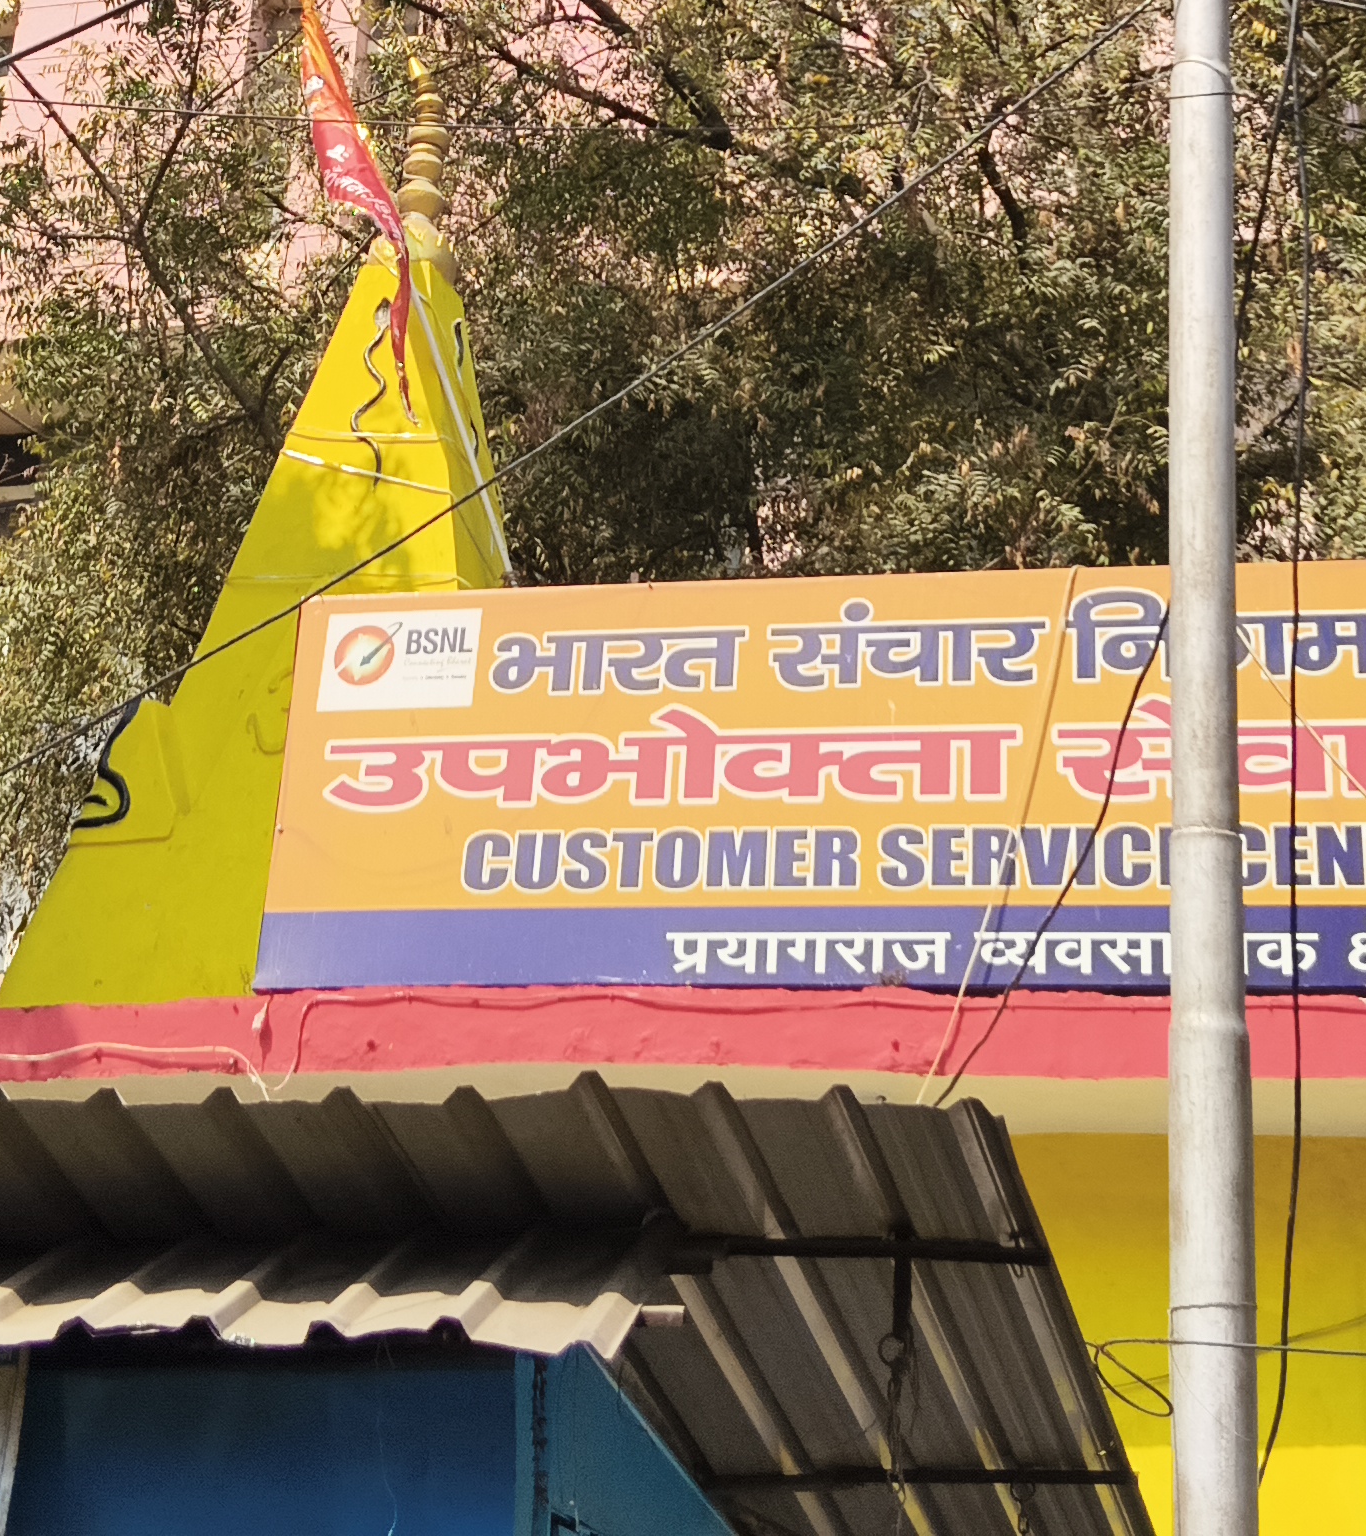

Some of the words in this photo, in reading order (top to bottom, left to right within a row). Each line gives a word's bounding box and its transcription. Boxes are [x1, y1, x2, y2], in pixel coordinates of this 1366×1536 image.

[405, 626, 473, 655] BSNL
[490, 626, 746, 695] भारत
[769, 598, 1048, 689] संचार
[323, 704, 1021, 811] उपभोक्ता
[461, 826, 861, 892] CUSTOMER
[880, 822, 1171, 891] SERVIC
[666, 929, 951, 976] प्रयागराज
